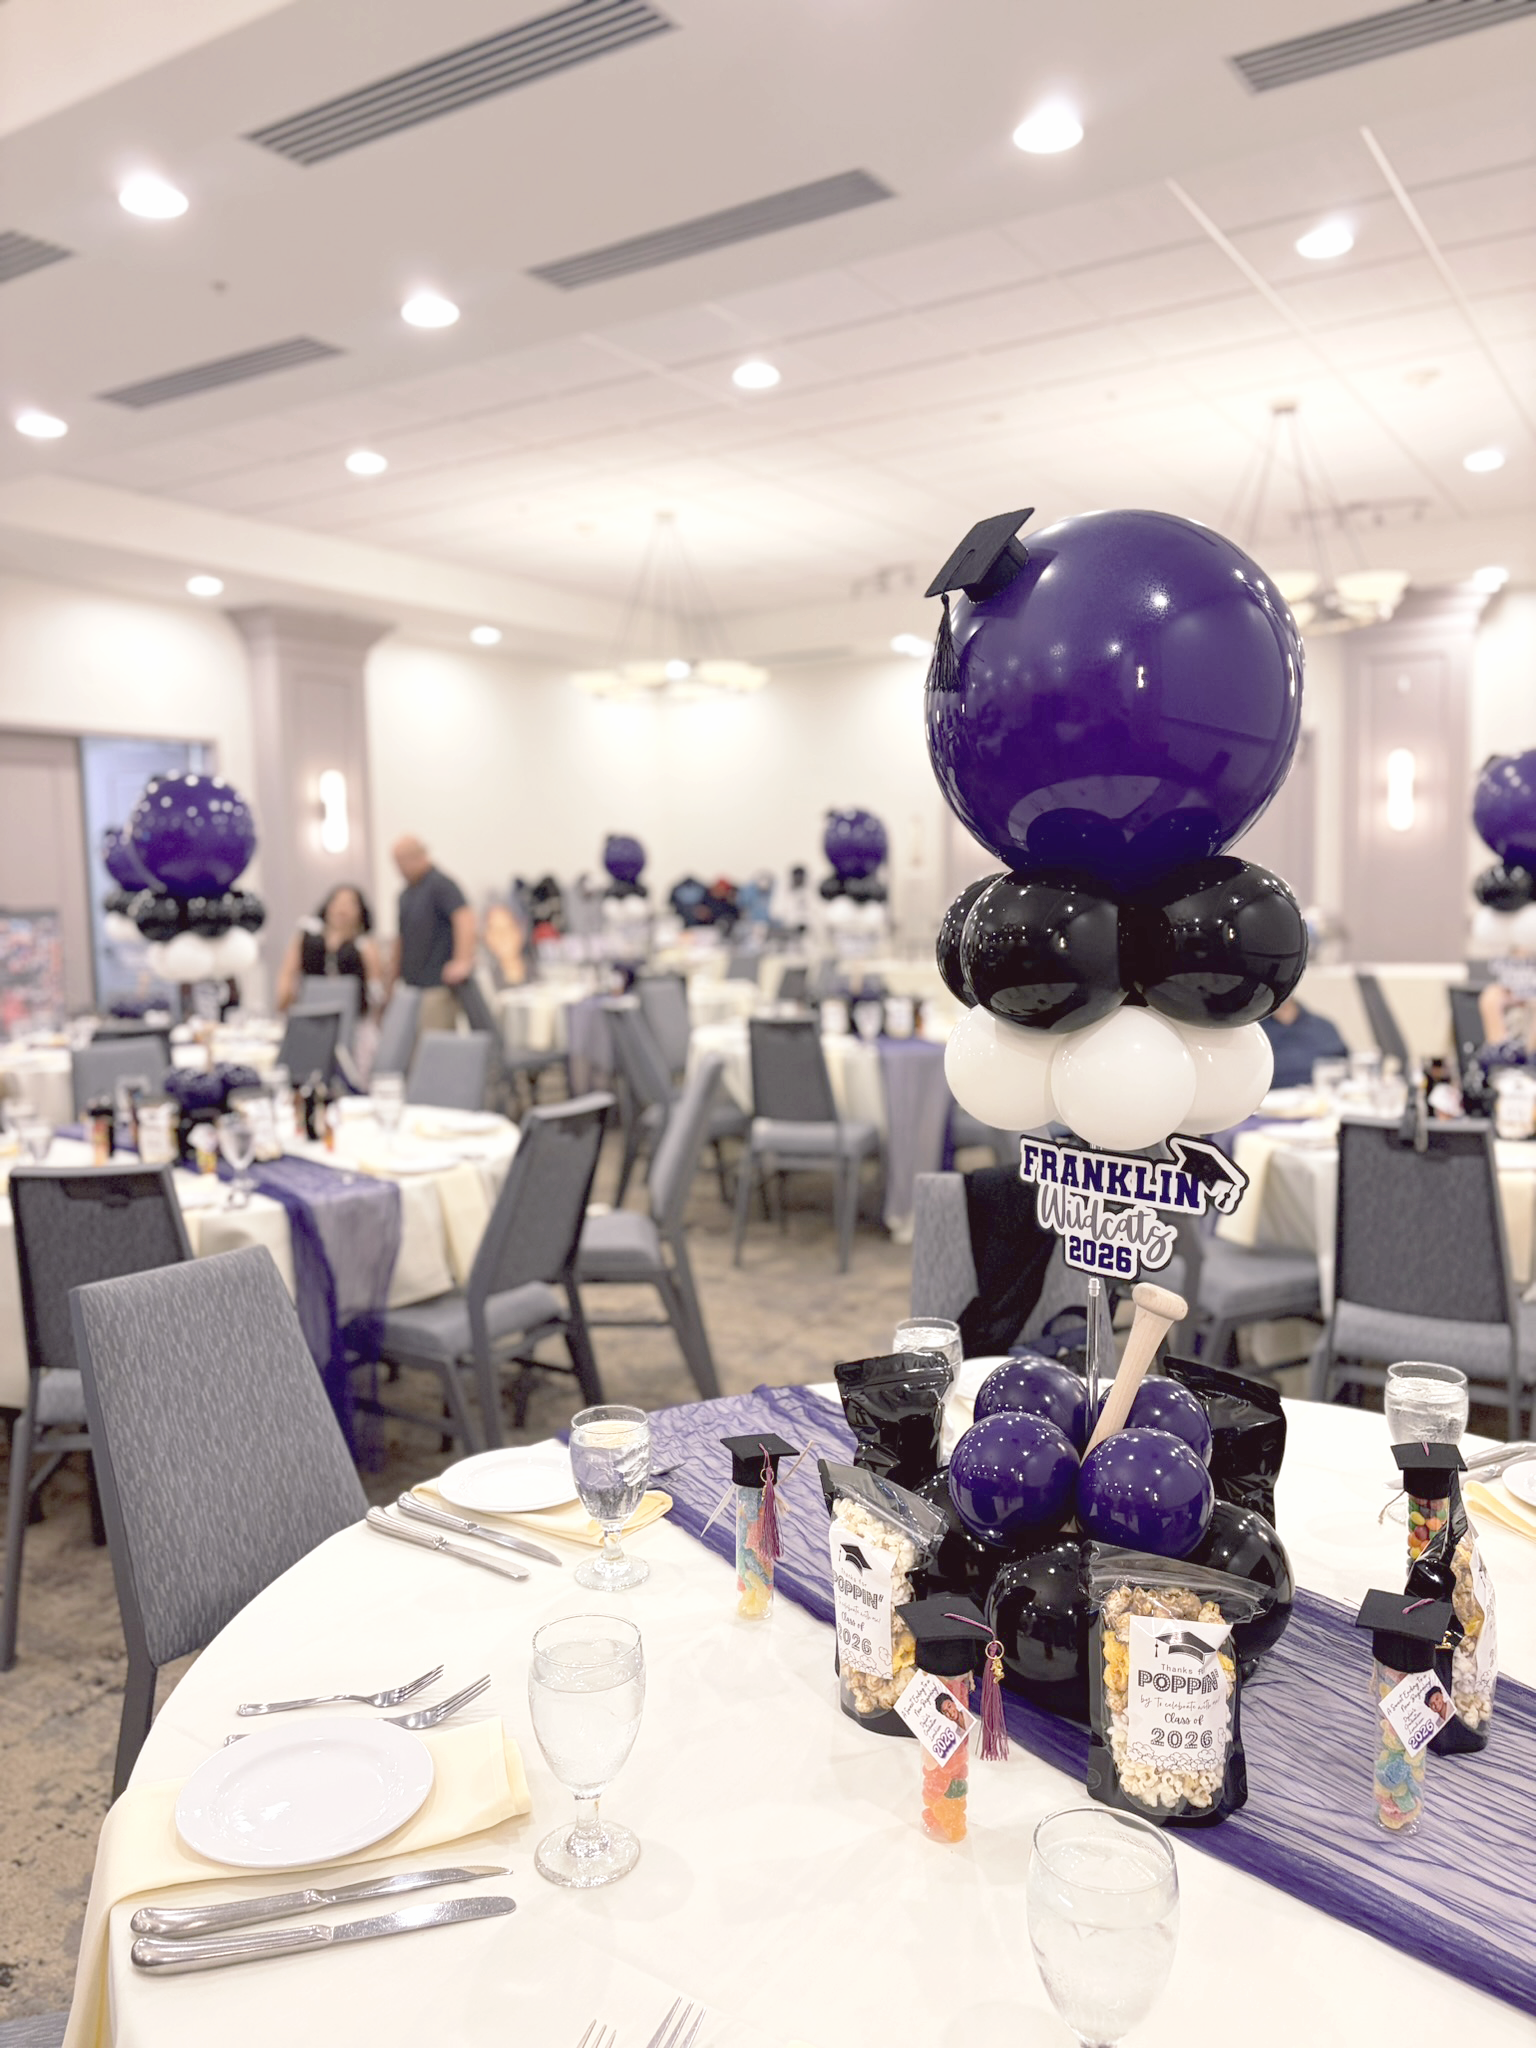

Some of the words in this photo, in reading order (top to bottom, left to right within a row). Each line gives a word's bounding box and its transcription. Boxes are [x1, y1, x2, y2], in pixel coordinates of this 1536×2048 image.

[1023, 1145, 1200, 1209] FRANKLIN
[1040, 1184, 1172, 1263] Wildcats
[1069, 1235, 1132, 1274] 2026
[857, 1621, 865, 1632] of
[1161, 1663, 1193, 1675] Thanks
[1140, 1694, 1152, 1708] by
[1164, 1701, 1196, 1712] celebrate
[1164, 1712, 1191, 1725] Class
[1193, 1714, 1204, 1726] of
[932, 1726, 957, 1758] 2026
[1150, 1727, 1213, 1749] 2026
[1407, 1719, 1435, 1750] 2026
